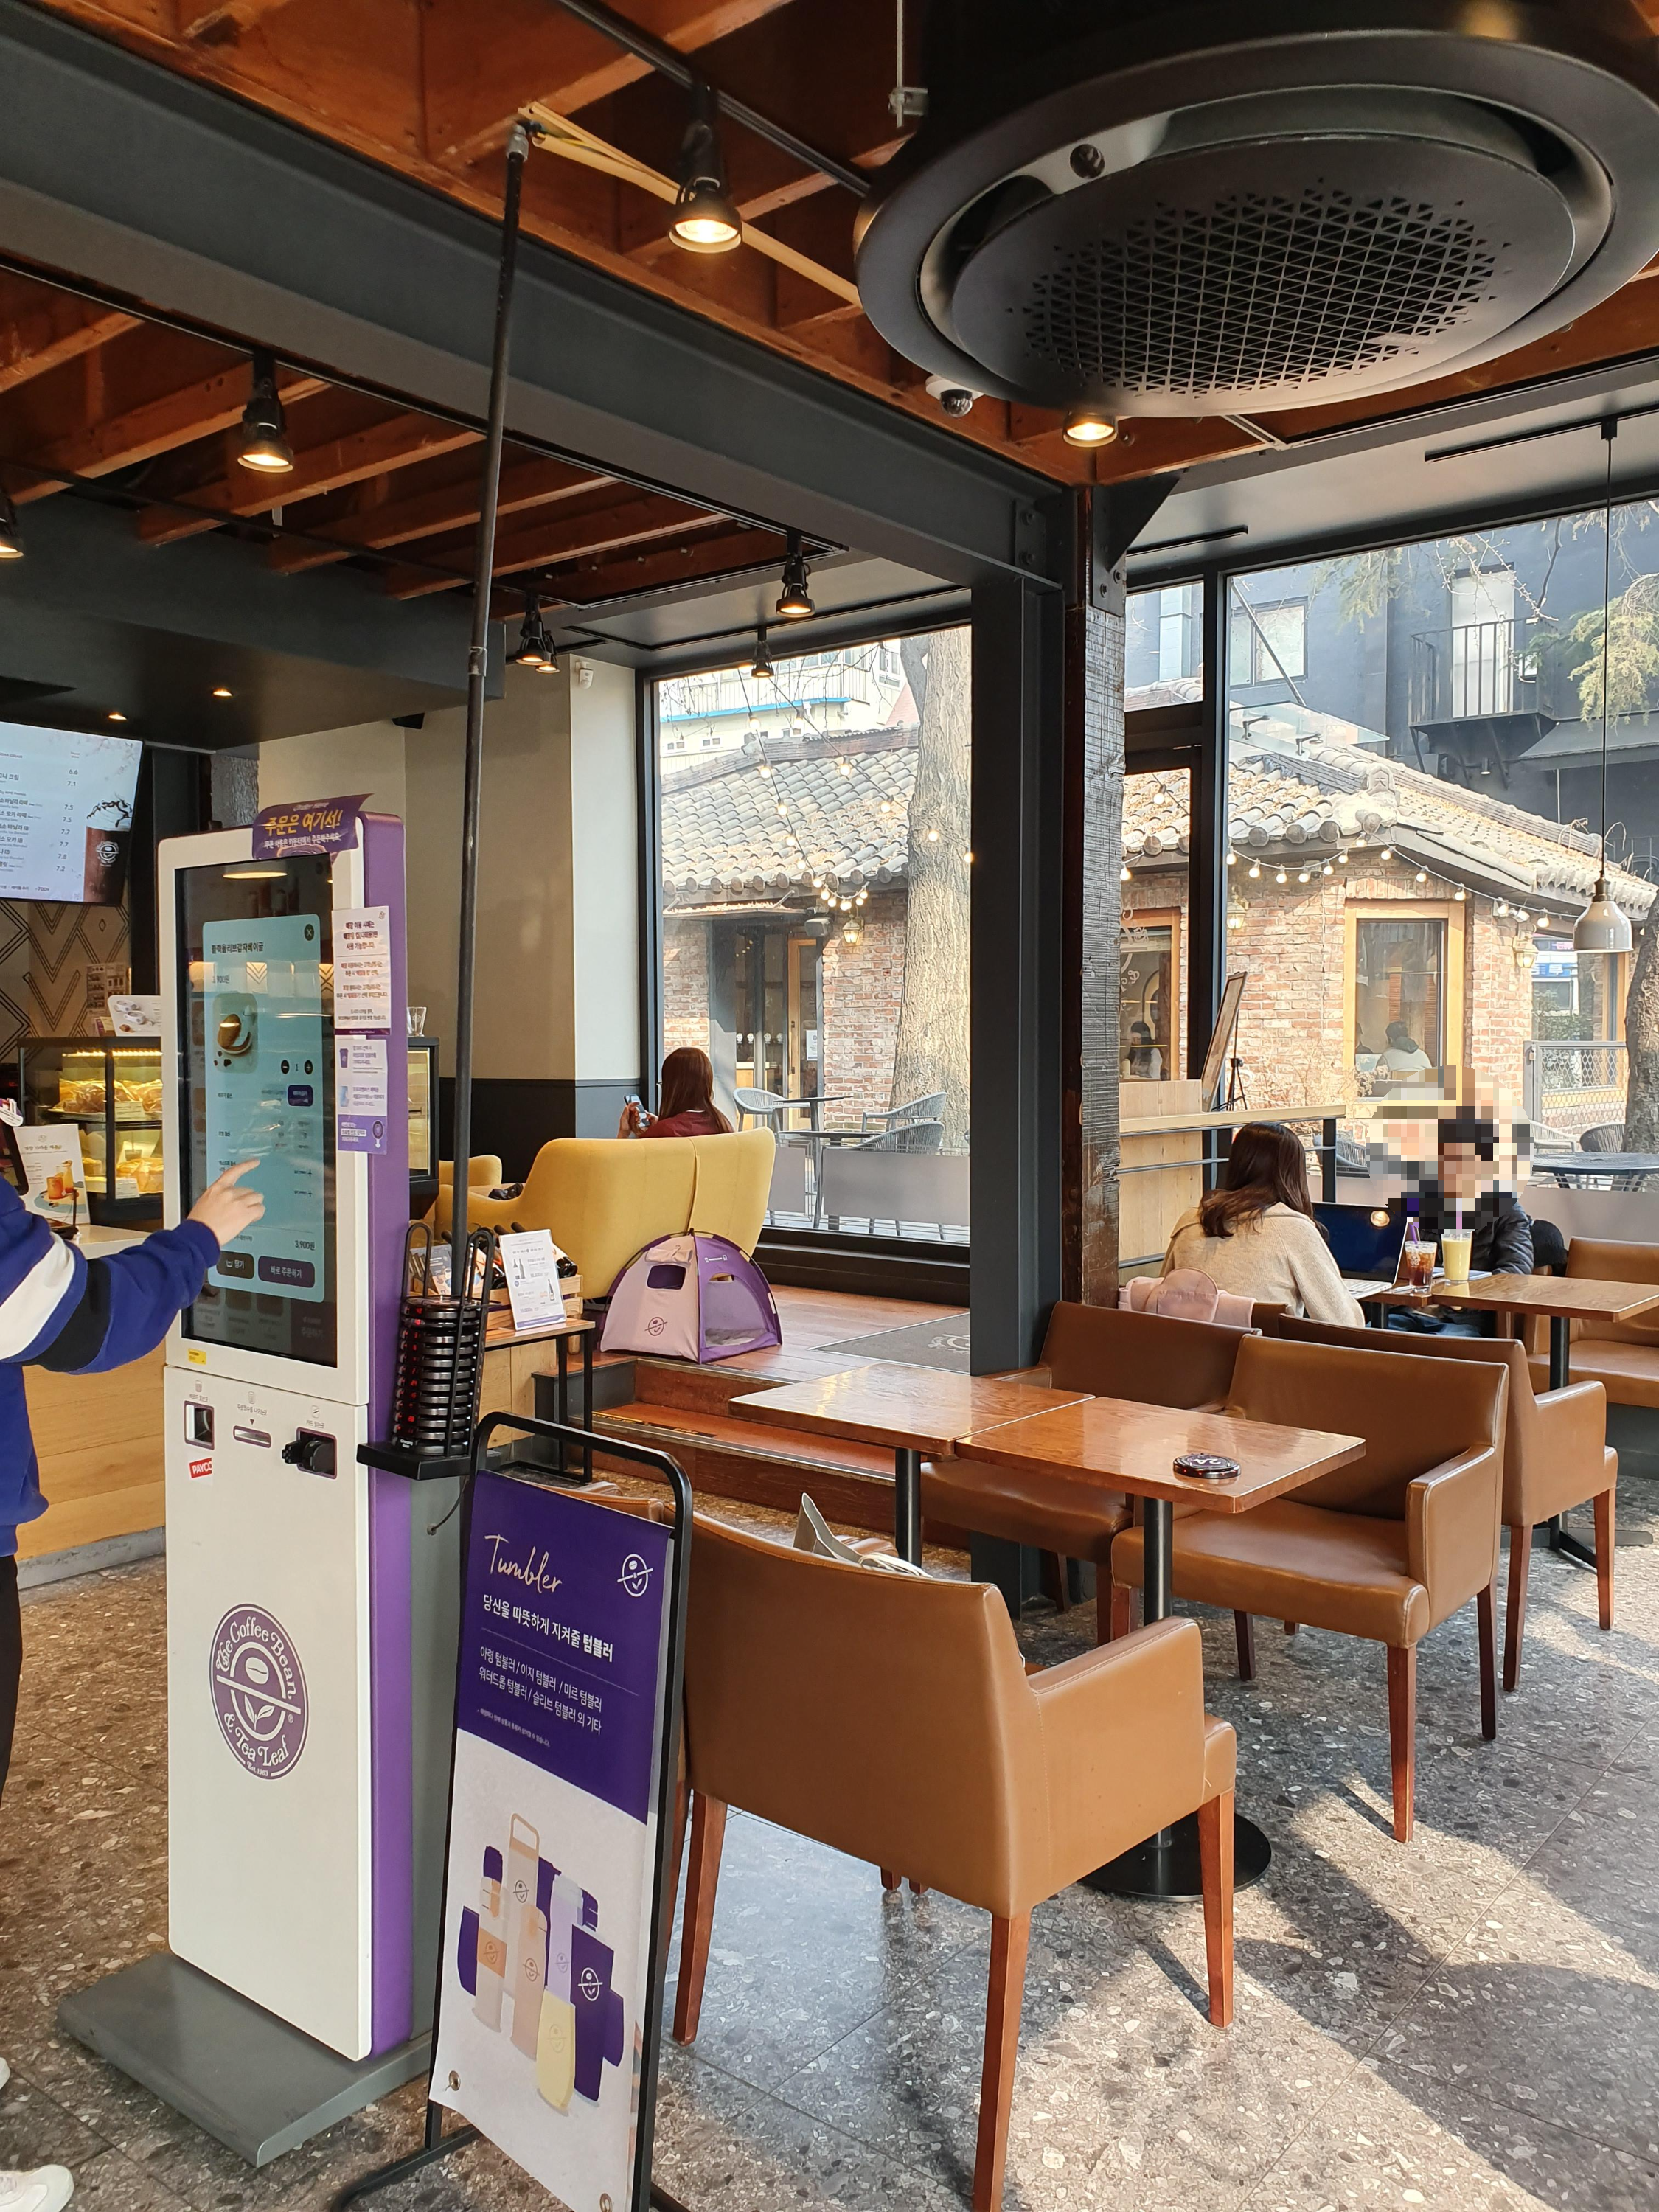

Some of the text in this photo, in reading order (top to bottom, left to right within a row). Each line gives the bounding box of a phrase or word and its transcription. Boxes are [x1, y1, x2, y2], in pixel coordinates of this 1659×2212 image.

[265, 809, 343, 836] 주문은 여기서!
[212, 942, 263, 954] 블랙올리브감자베이글
[294, 1239, 316, 1251] 3,900원
[234, 1259, 245, 1270] 담기
[270, 1265, 302, 1279] 바로 주문하기
[192, 1461, 213, 1475] PAYCO
[484, 1534, 562, 1594] Tumbler
[483, 1593, 613, 1663] 당신을 따뜻하게 지켜줄 텀블러
[215, 1615, 296, 1700] The Coffee Bean
[480, 1646, 494, 1663] 아령
[495, 1652, 515, 1673] 텀블러
[521, 1663, 535, 1682] 이지
[535, 1669, 557, 1692] 텀블러
[563, 1683, 579, 1700] 미르
[580, 1689, 602, 1713] 텀블러
[479, 1666, 506, 1690] 워터드롭
[507, 1678, 527, 1702] 텀블러
[532, 1691, 553, 1711] 슬리브
[554, 1700, 576, 1723] 텀블러
[577, 1711, 585, 1728] 외
[586, 1715, 602, 1735] 기타
[223, 1711, 290, 1767] & Tea Leaf
[257, 1767, 268, 1777] 1963
